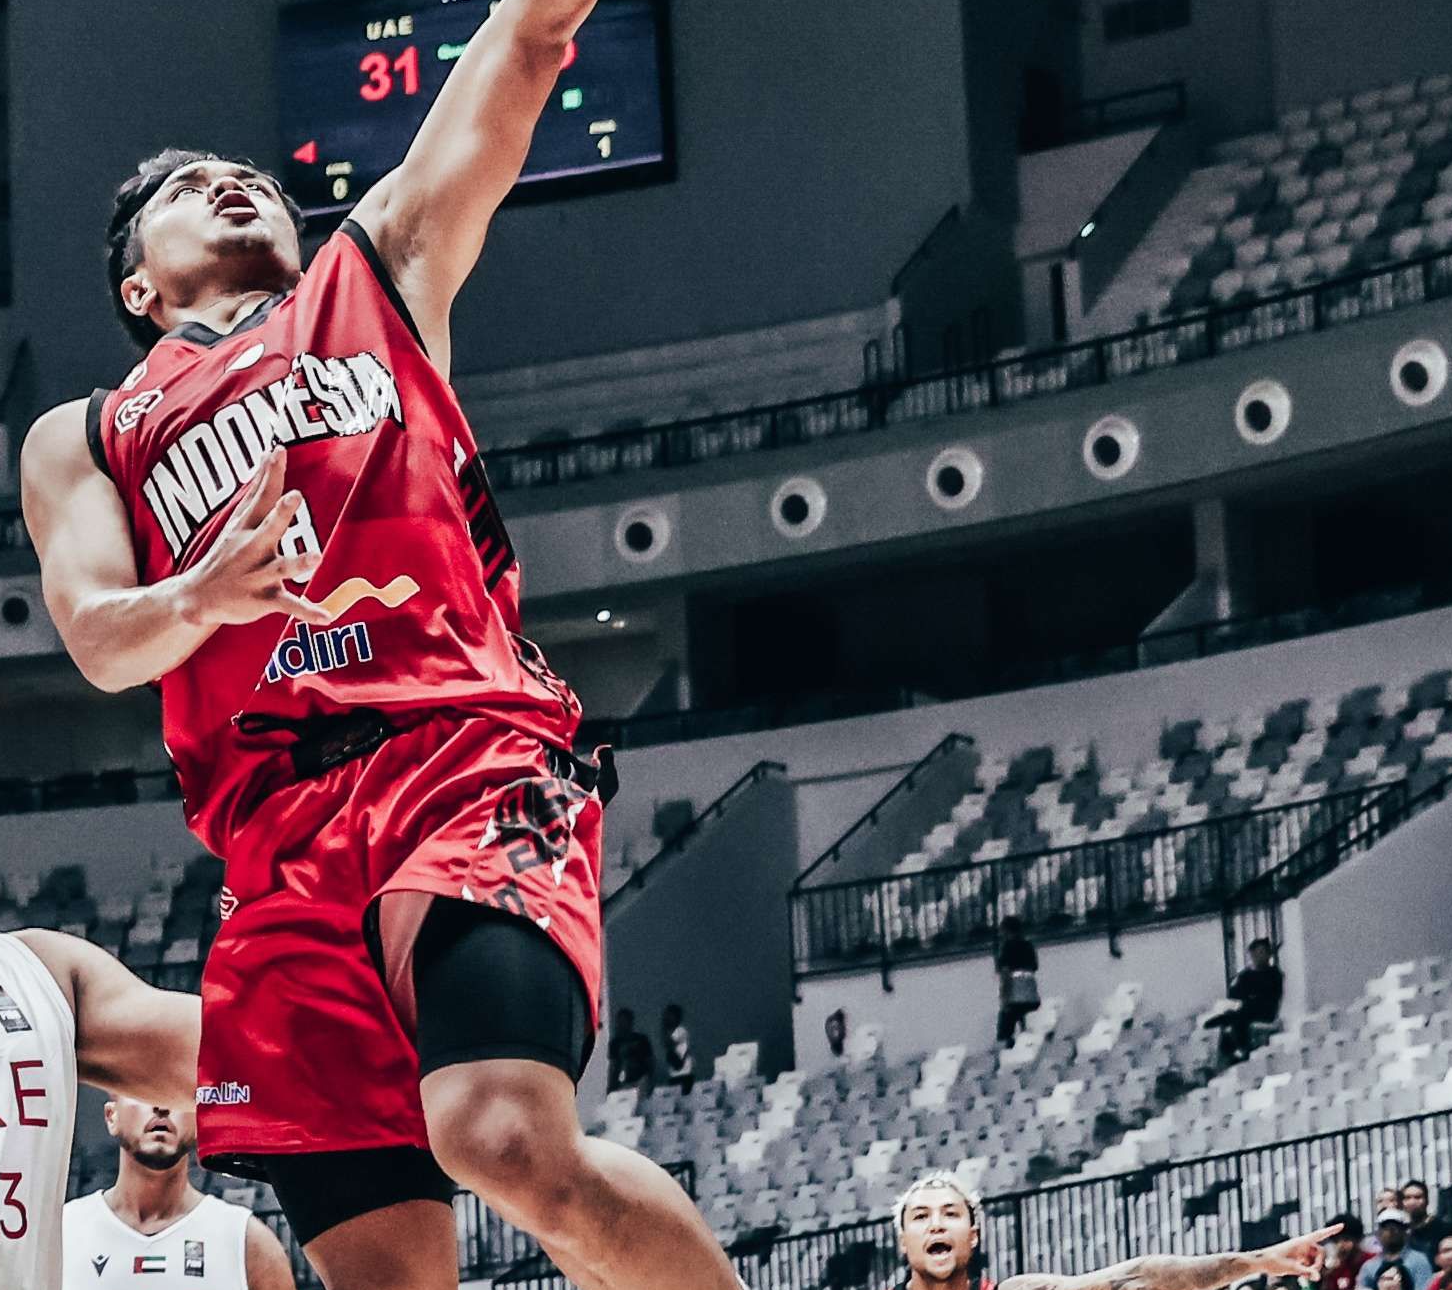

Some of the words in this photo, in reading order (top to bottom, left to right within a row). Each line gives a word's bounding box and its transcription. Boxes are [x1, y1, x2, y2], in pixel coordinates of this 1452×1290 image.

[366, 14, 414, 41] UAE
[359, 44, 420, 102] 31
[142, 350, 405, 560] INDONESIA
